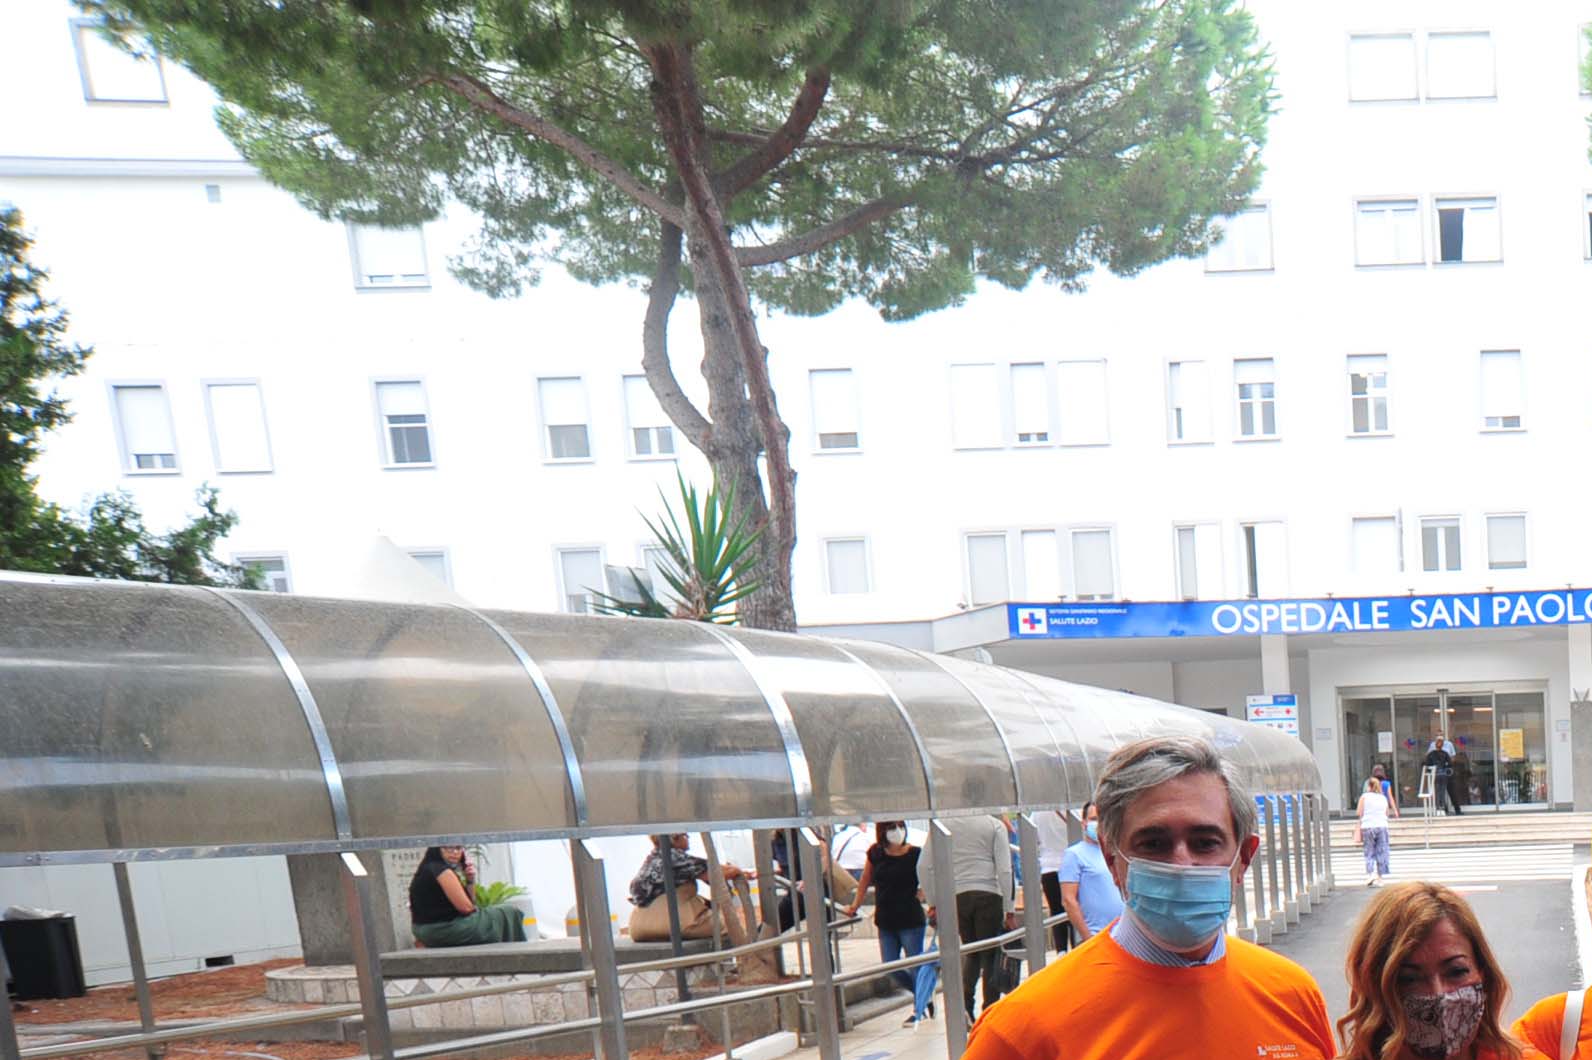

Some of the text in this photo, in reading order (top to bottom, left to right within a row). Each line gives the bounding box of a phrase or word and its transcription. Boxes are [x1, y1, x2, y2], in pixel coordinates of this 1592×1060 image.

[1050, 617, 1098, 625] SALUTE LAZIO
[1212, 600, 1389, 633] OSPEDALE
[1410, 597, 1480, 628] SAN
